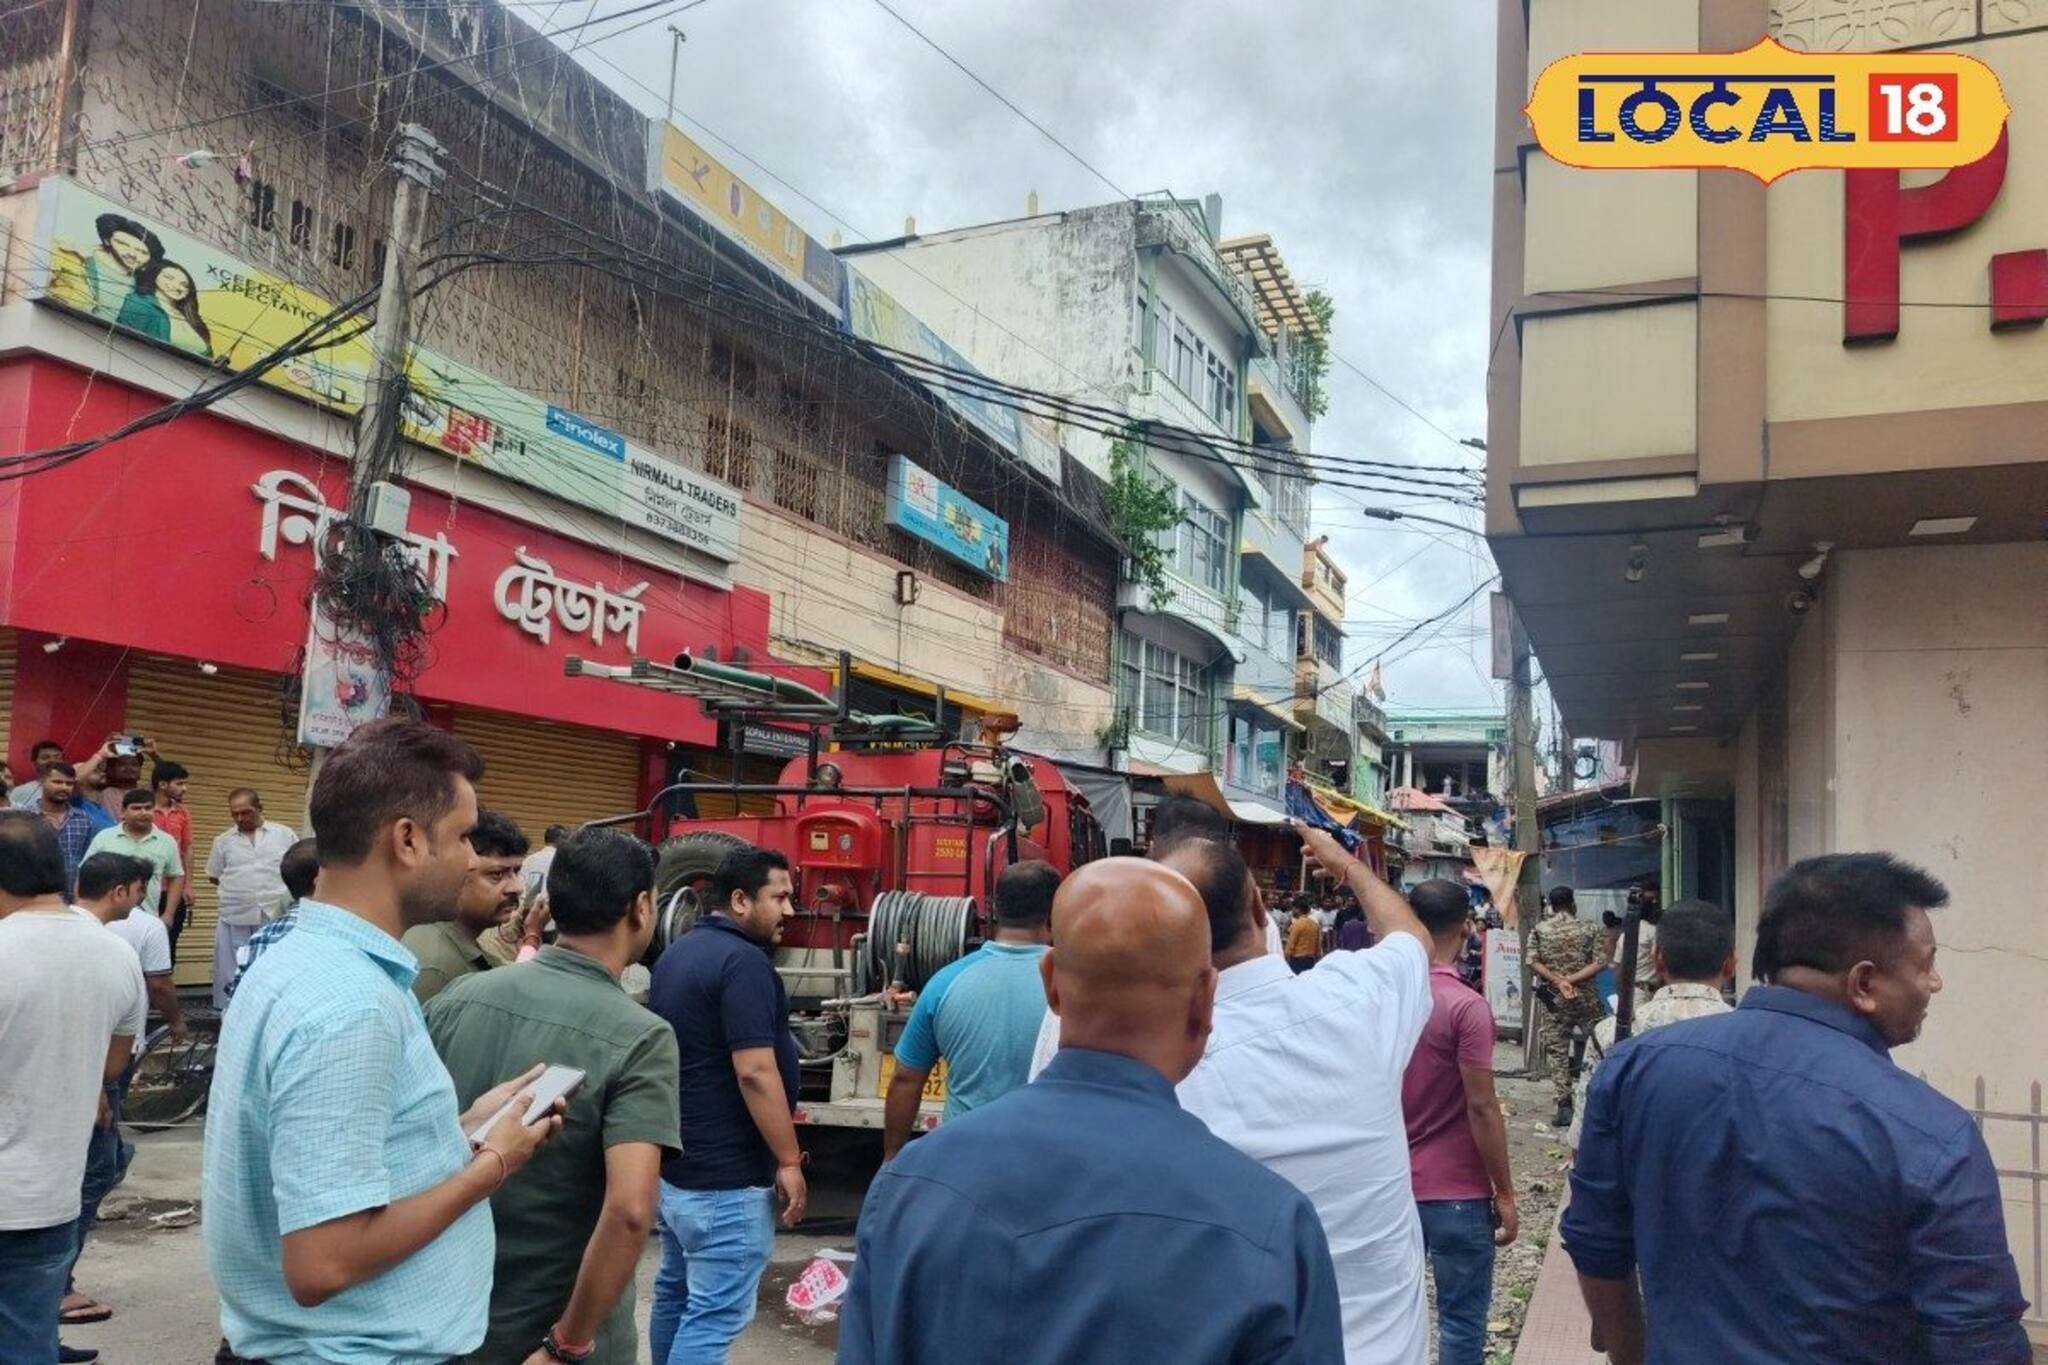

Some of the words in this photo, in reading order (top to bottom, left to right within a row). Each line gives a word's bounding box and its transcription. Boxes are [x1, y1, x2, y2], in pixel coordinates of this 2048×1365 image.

[219, 279, 330, 325] XPECTATIO
[553, 411, 619, 454] Finolex
[630, 458, 684, 495] NIRMALA
[687, 482, 737, 518] TRADERS
[494, 545, 650, 654] ট্রেডার্স
